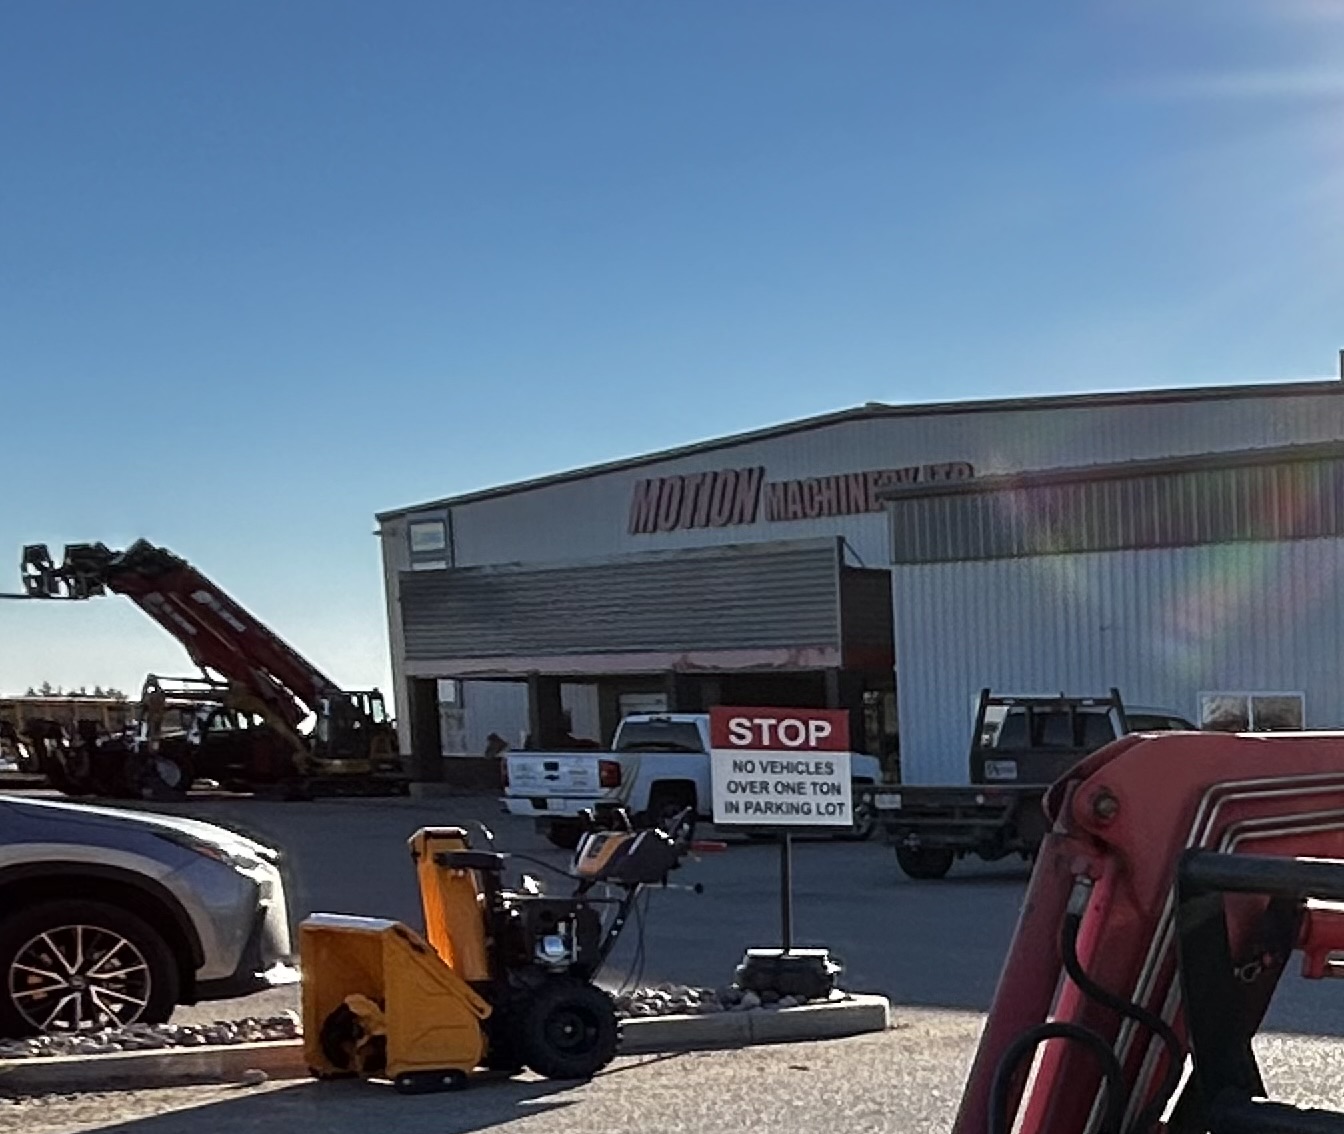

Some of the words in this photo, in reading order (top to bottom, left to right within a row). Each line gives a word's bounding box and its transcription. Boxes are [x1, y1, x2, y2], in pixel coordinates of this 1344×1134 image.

[628, 466, 766, 535] MOTION
[728, 717, 832, 747] STOP
[732, 760, 756, 774] NO
[759, 760, 834, 776] VEHICLES
[726, 780, 770, 795] OVER
[774, 780, 807, 796] ONE
[810, 781, 842, 796] TON
[724, 801, 740, 815] IN
[744, 801, 812, 816] PARKING
[816, 802, 846, 816] LOT
